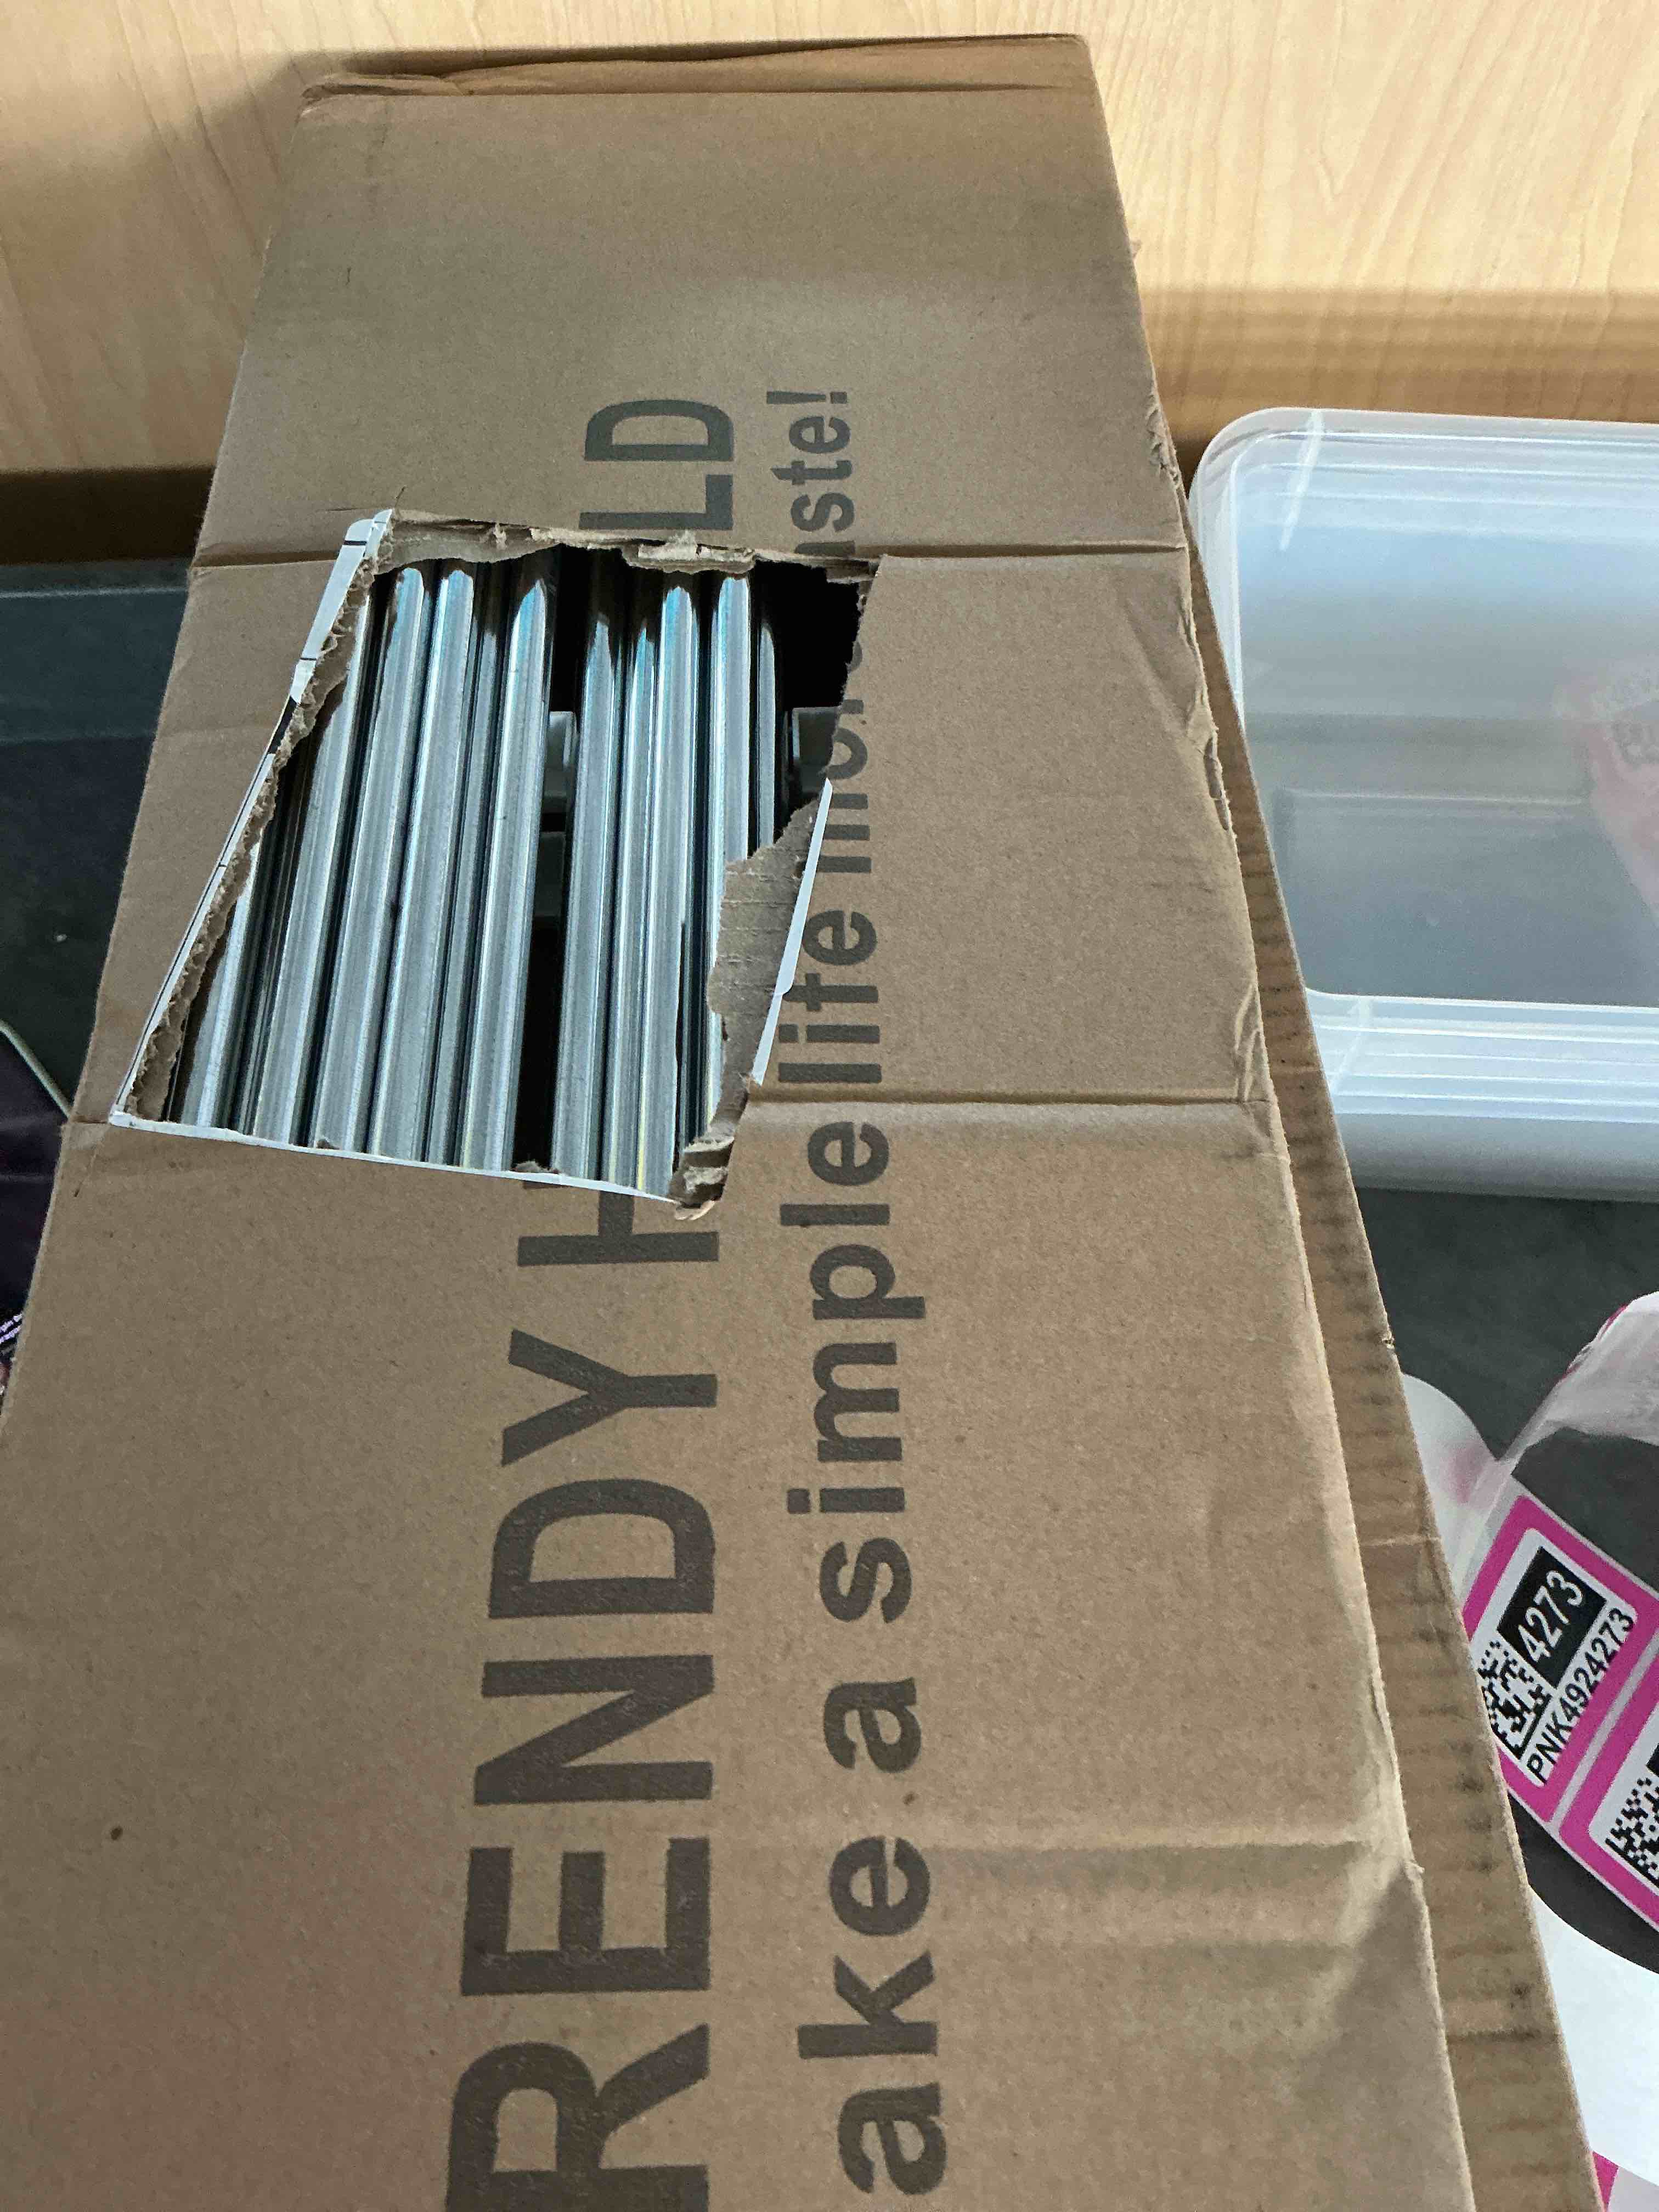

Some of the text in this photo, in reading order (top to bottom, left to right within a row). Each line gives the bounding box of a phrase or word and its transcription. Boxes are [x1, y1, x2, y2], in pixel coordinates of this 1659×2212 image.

[779, 1121, 926, 1624] simple
[1518, 1570, 1583, 1662] 4273
[823, 1677, 922, 1774] a
[1526, 1607, 1635, 1785] PNK4924273
